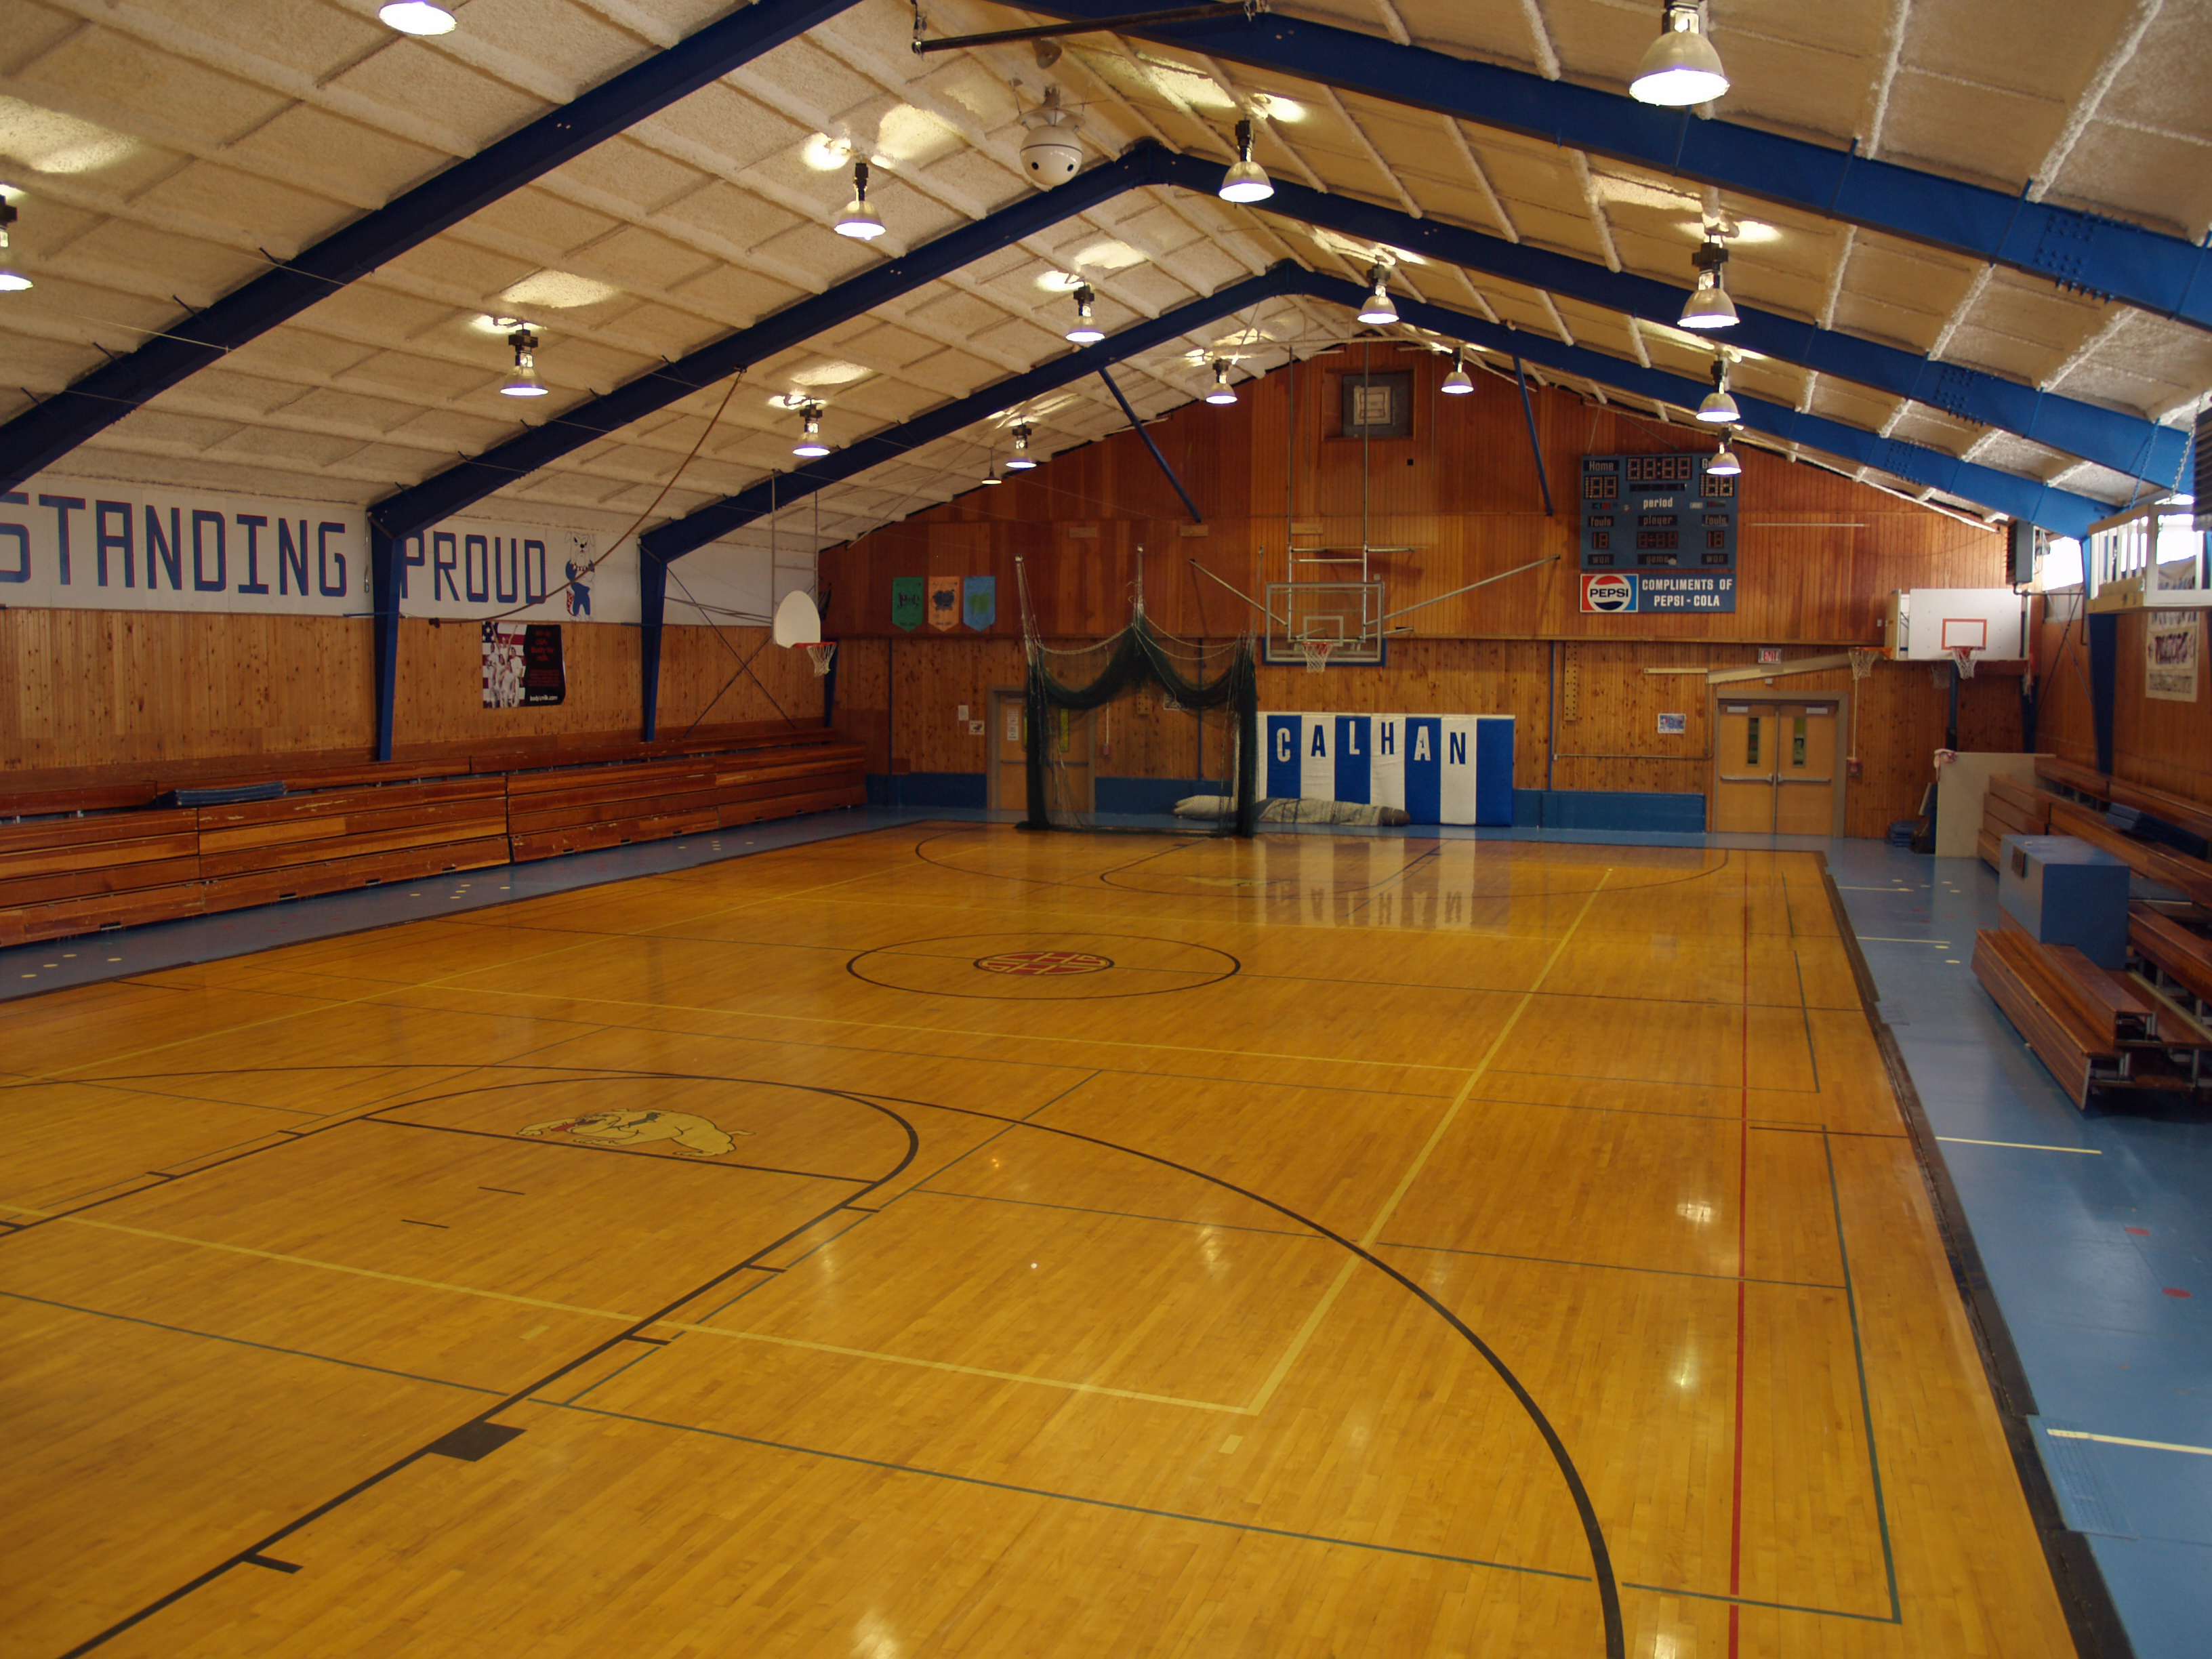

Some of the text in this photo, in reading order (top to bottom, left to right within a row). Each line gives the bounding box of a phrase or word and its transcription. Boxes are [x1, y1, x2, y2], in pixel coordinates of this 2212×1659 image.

[1589, 461, 1614, 471] Home
[1643, 497, 1673, 509] period
[1591, 516, 1611, 527] fouls
[1643, 515, 1672, 526] player
[1705, 516, 1726, 525] fouls
[0, 491, 546, 604] STANDING PROUD
[1646, 555, 1668, 565] game
[1642, 579, 1732, 590] COMPLIMENTS OF
[1590, 589, 1629, 597] PEPSI
[1654, 595, 1684, 607] PEPSI
[1694, 596, 1719, 606] COLA
[1276, 720, 1467, 765] CALHAN
